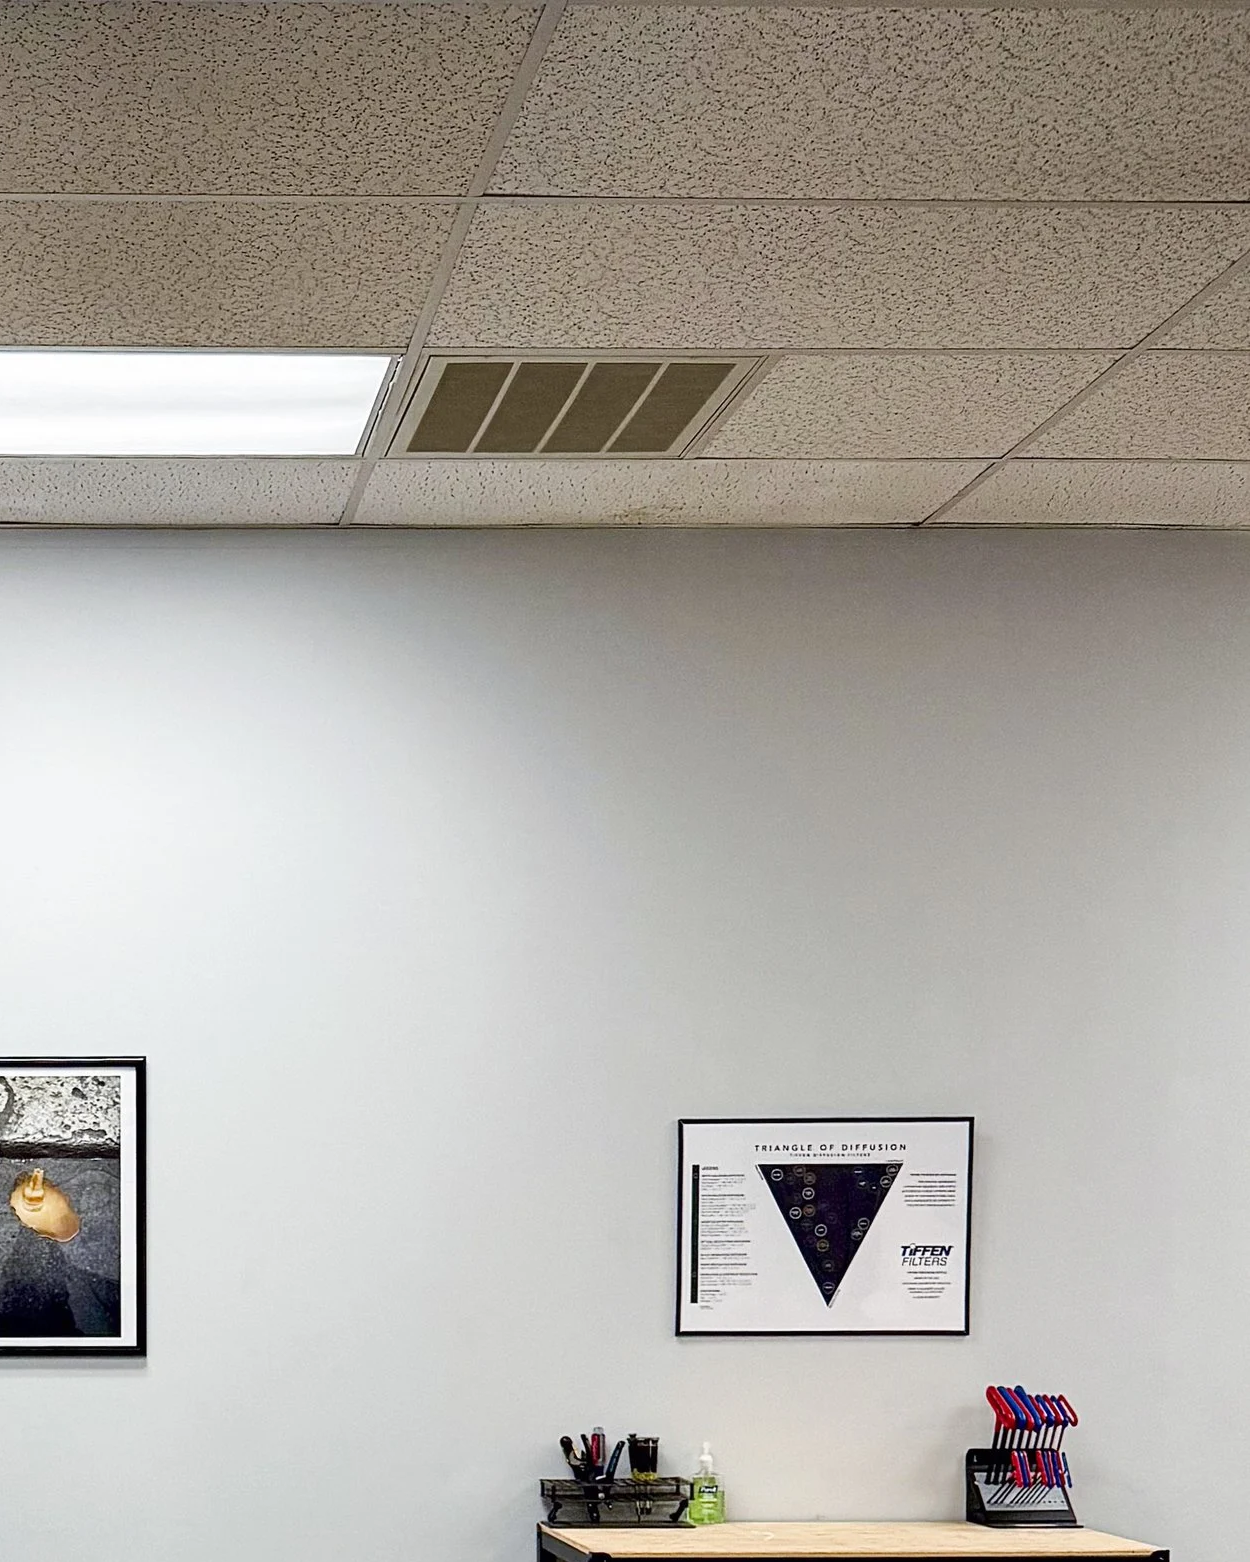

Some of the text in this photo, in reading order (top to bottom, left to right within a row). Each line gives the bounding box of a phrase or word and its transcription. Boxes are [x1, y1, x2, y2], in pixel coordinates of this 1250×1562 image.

[754, 1143, 907, 1152] TRIANGLE OF DIFFUSION
[901, 1257, 948, 1267] FILTERS
